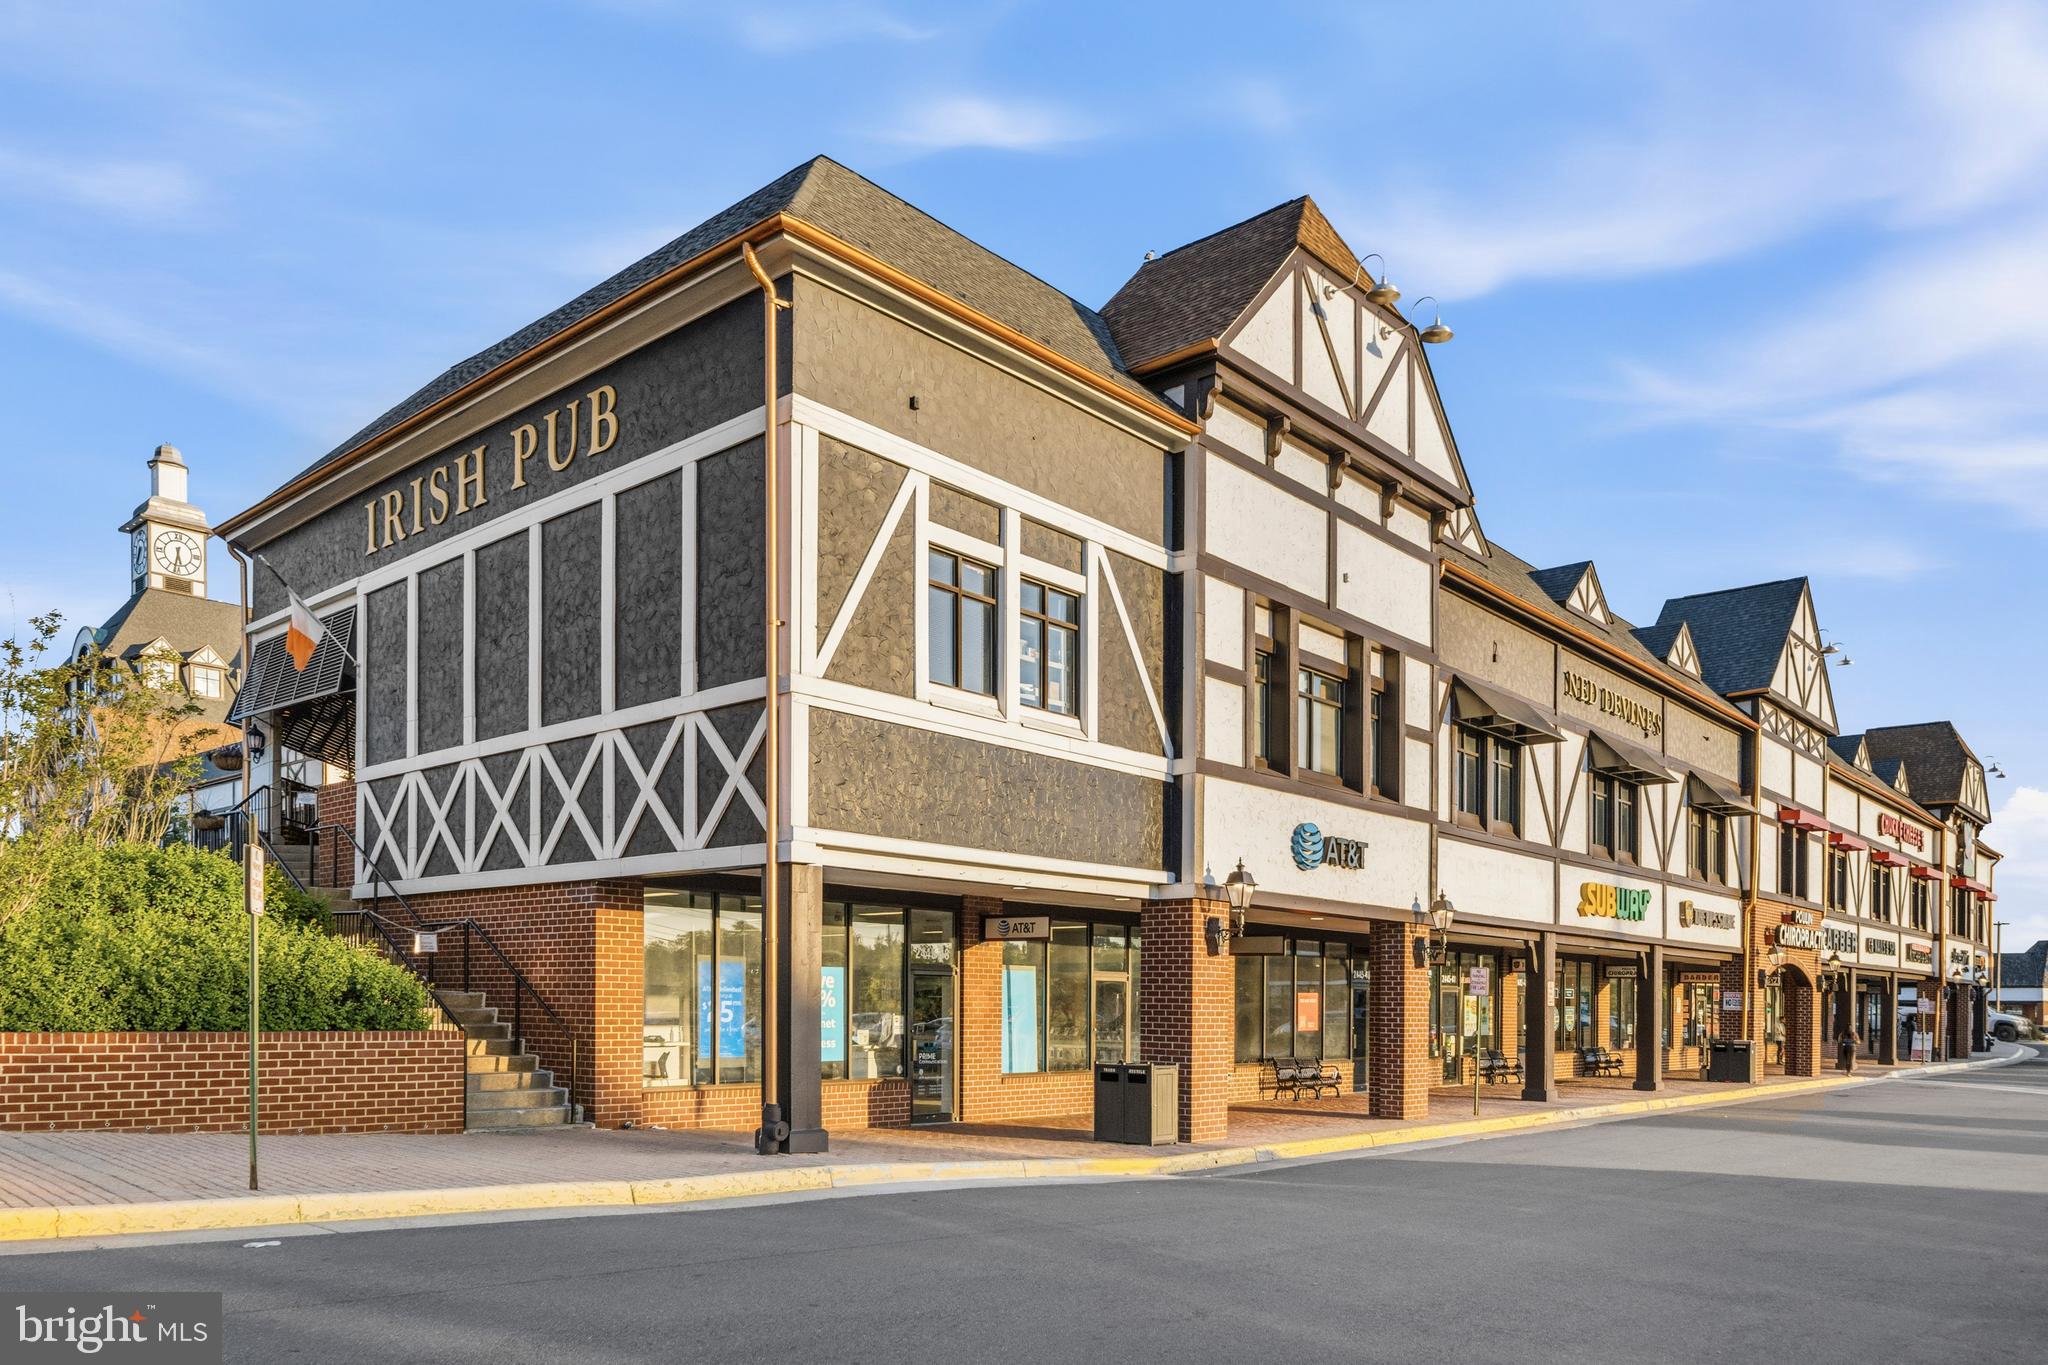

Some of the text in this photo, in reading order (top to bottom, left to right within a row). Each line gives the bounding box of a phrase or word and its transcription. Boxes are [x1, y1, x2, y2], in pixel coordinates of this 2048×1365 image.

[364, 384, 620, 556] IRISH PUB
[1563, 671, 1597, 706] NED
[1324, 836, 1369, 869] AT&T
[1577, 882, 1652, 922] SUBWAY
[1012, 922, 1036, 933] AT&T
[1779, 923, 1828, 951] CHIROPRACTIC
[919, 1052, 936, 1060] PRIME
